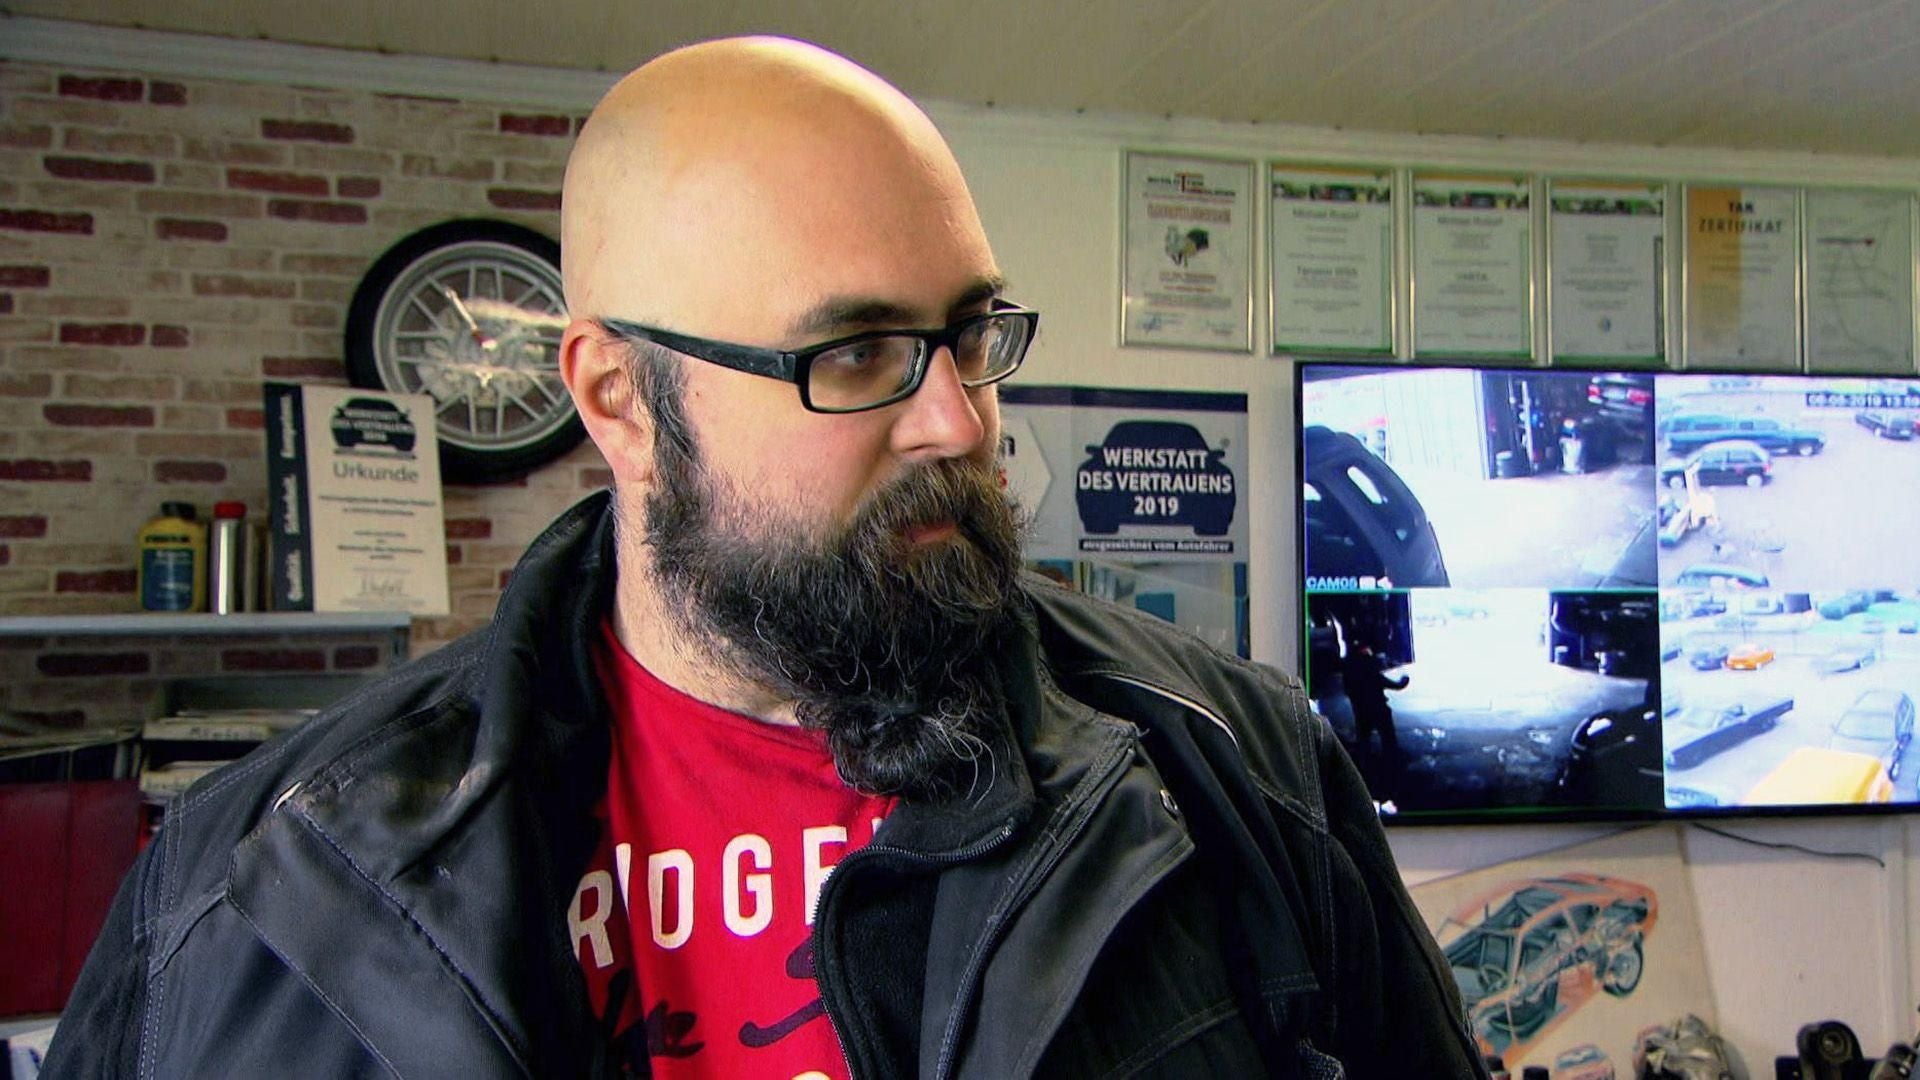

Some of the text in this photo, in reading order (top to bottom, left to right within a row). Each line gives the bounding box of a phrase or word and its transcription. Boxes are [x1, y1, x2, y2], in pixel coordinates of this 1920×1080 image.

[1698, 219, 1784, 234] ZERTIFIKAT
[1103, 447, 1209, 469] WERKSTATT
[333, 460, 418, 483] Urkunde
[1079, 472, 1233, 493] DES VERTRAUENS
[1133, 496, 1179, 516] 2019
[1154, 542, 1175, 551] vom
[1177, 541, 1230, 553] Autofahrer
